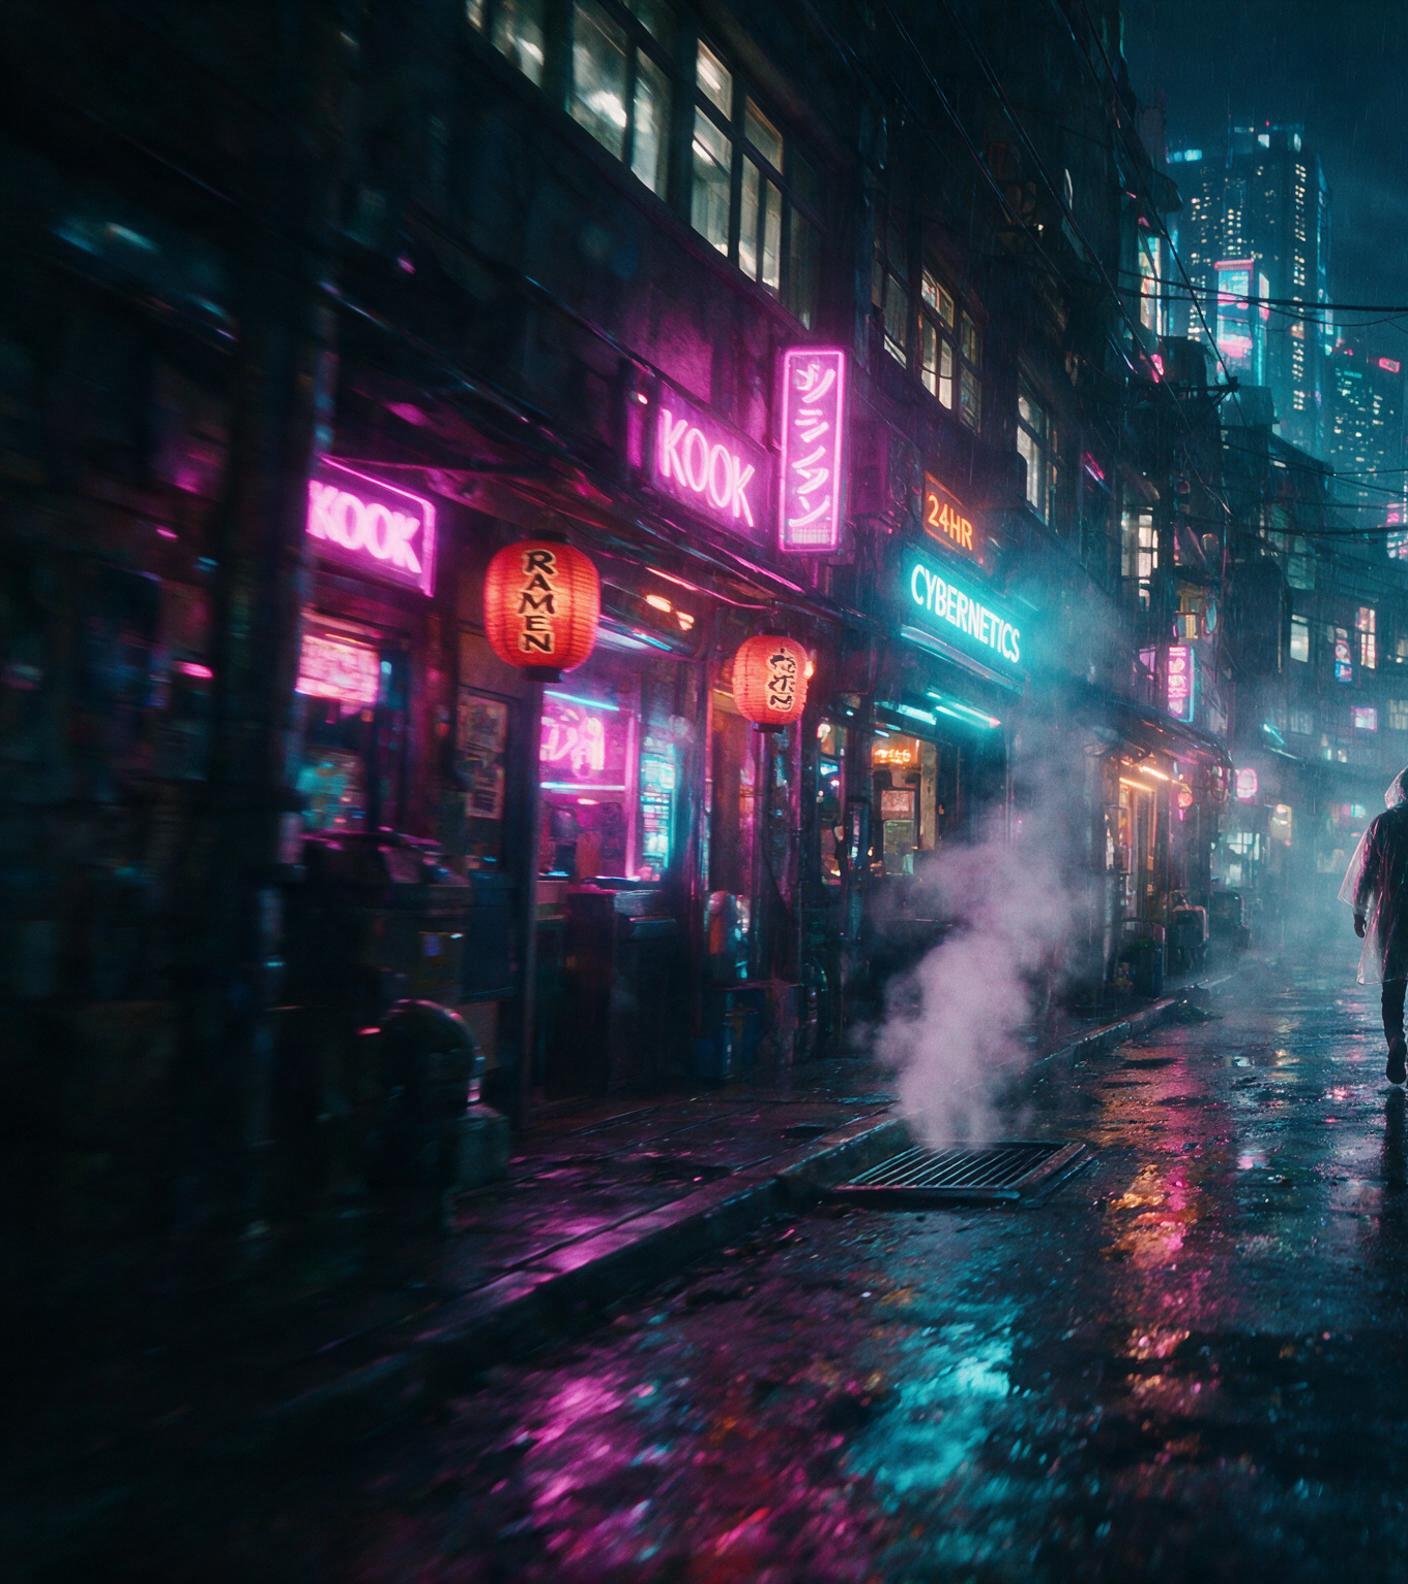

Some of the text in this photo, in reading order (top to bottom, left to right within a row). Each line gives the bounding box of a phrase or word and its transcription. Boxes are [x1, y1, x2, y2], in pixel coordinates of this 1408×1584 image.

[661, 407, 757, 529] KOOK
[306, 479, 423, 575] KOOK
[927, 494, 974, 552] 24HR
[517, 550, 556, 654] RAMEN
[910, 563, 1021, 664] CYBERNETICS
